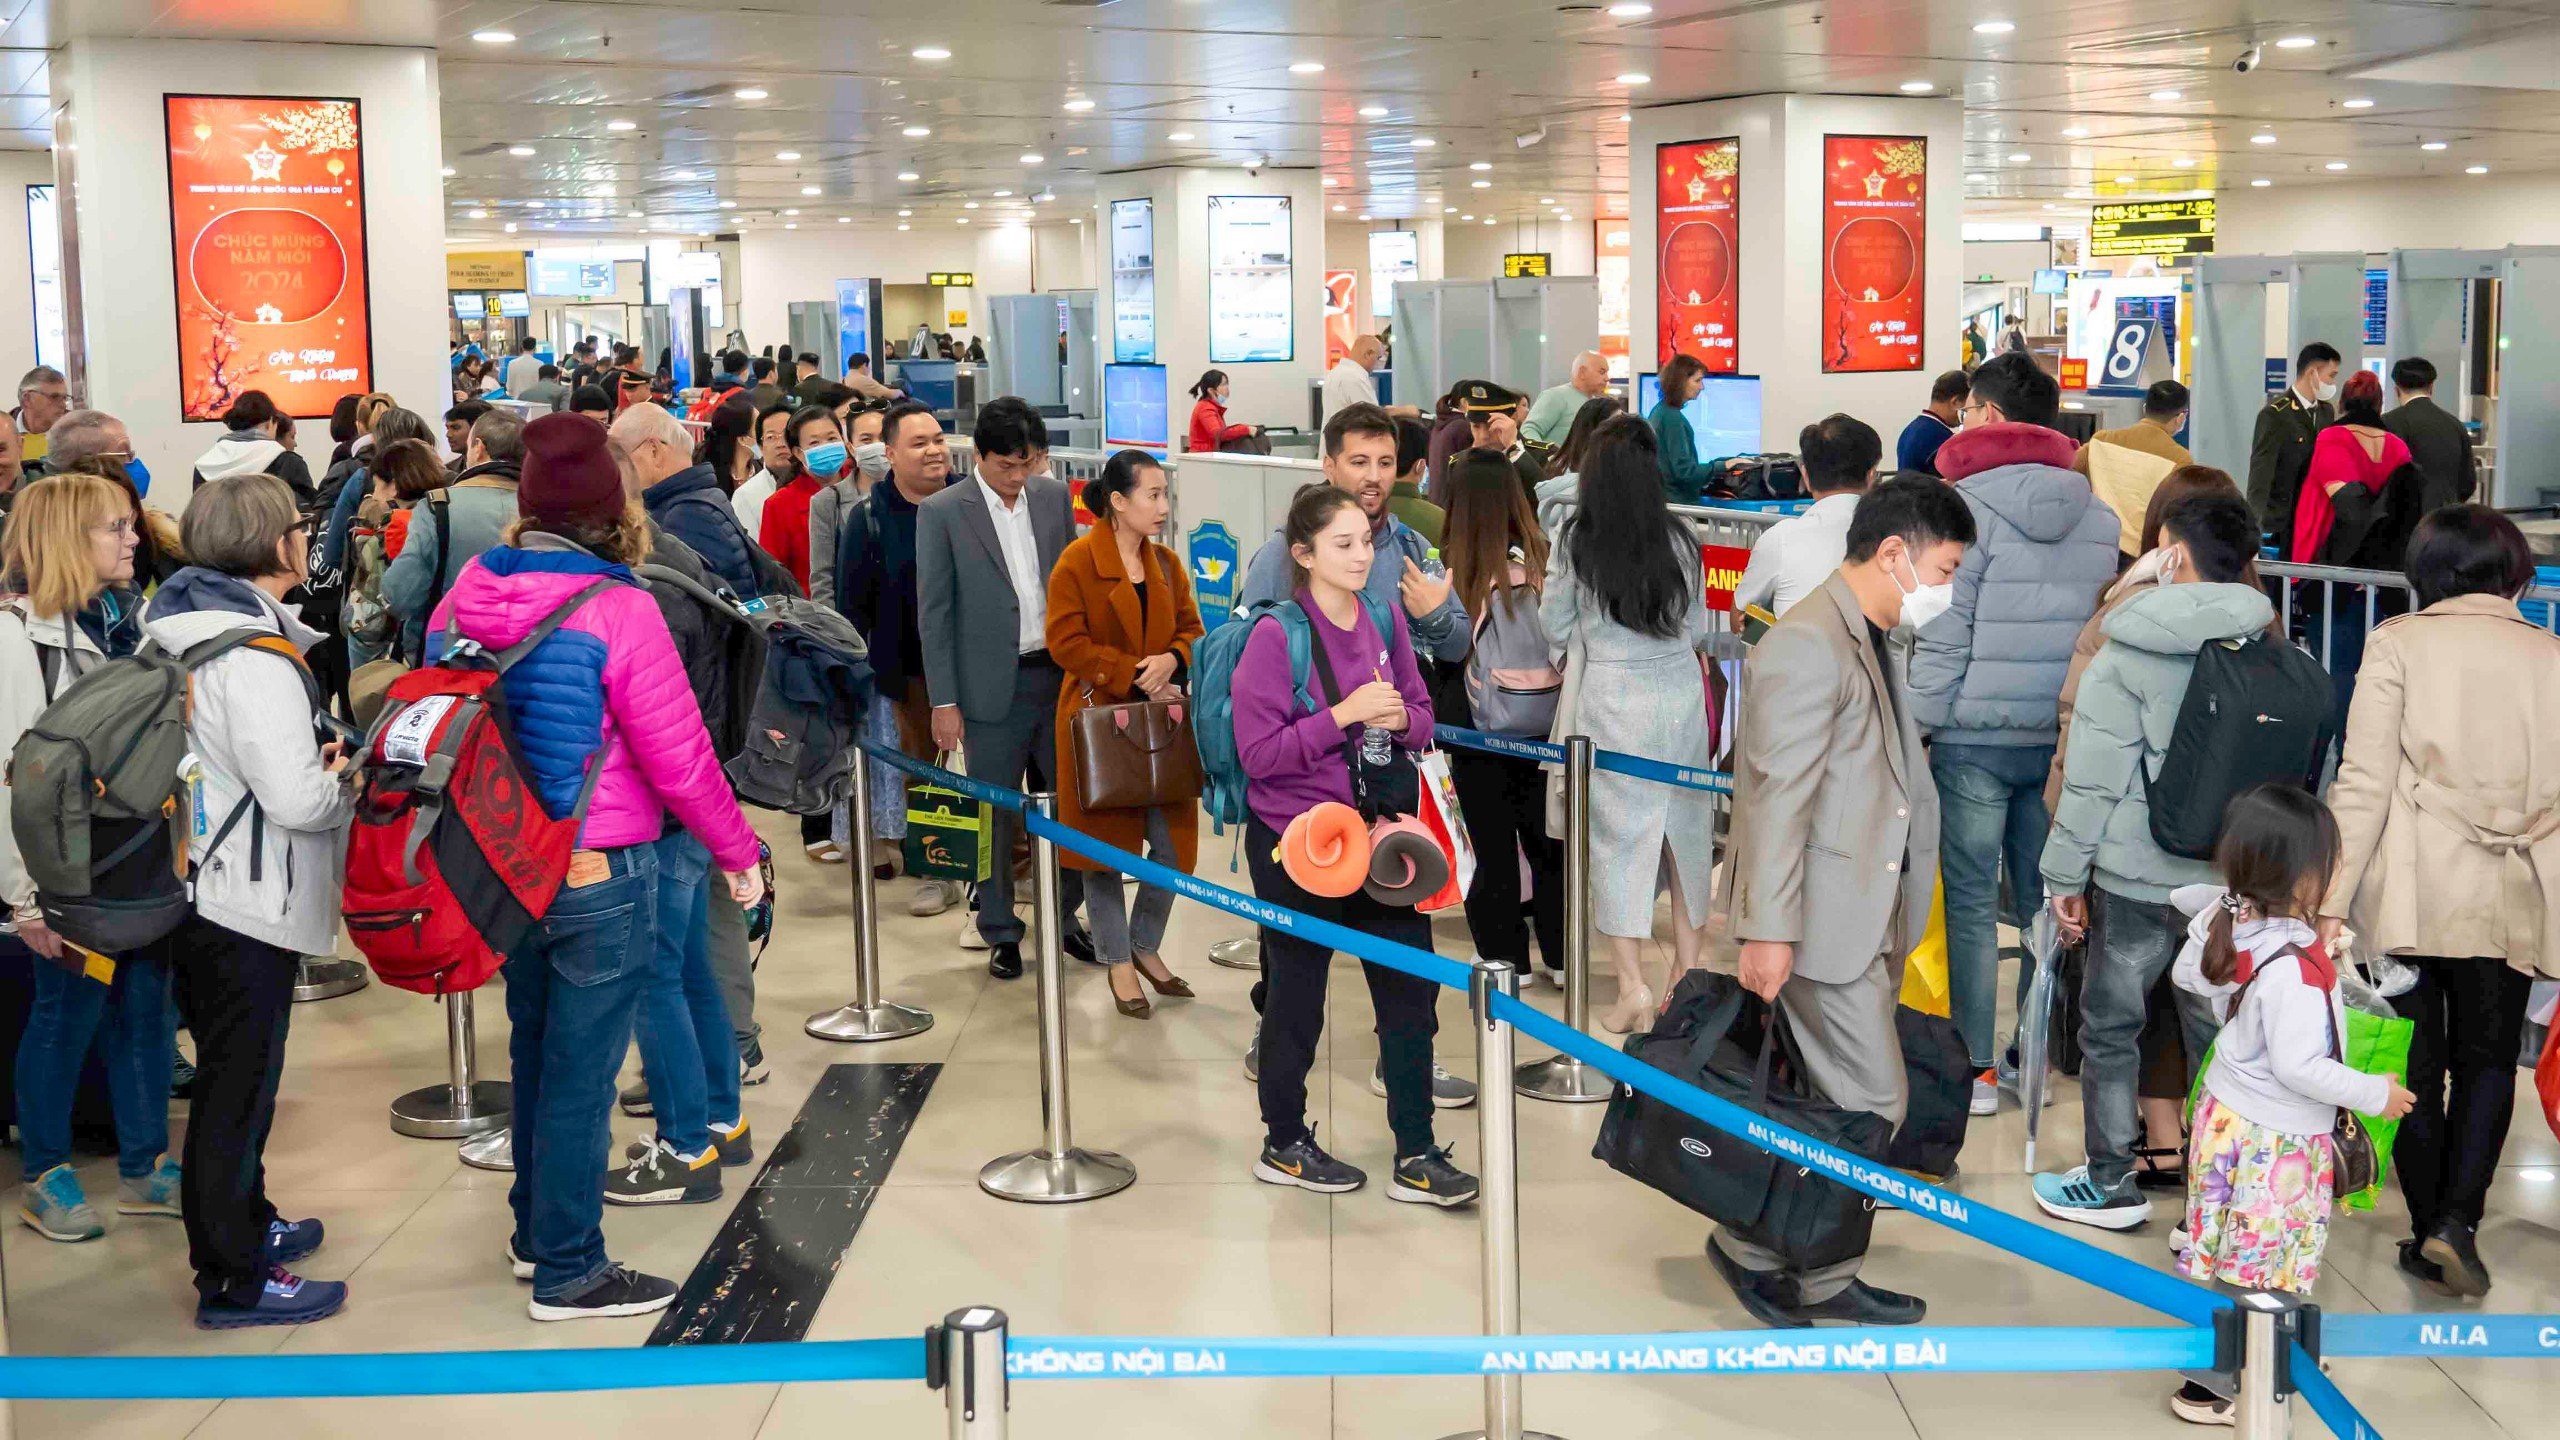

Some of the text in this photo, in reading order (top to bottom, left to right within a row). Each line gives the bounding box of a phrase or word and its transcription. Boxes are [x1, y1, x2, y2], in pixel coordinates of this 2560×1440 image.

[213, 231, 326, 250] CHÚC MỪNG
[230, 248, 312, 264] NĂM MỚI
[489, 299, 501, 312] 10
[2109, 324, 2146, 379] 8
[1508, 743, 1563, 760] INTERNATIONAL
[1747, 1121, 1968, 1224] AN NINH HÀNG KHÔNG NỘI BÀI
[2420, 1324, 2490, 1346] N.I.A
[1112, 1347, 1166, 1375] NỘI
[1172, 1348, 1226, 1372] BÀI
[1481, 1338, 1947, 1370] AN NINH HÀNG KHÔNG NỘI BÀI
